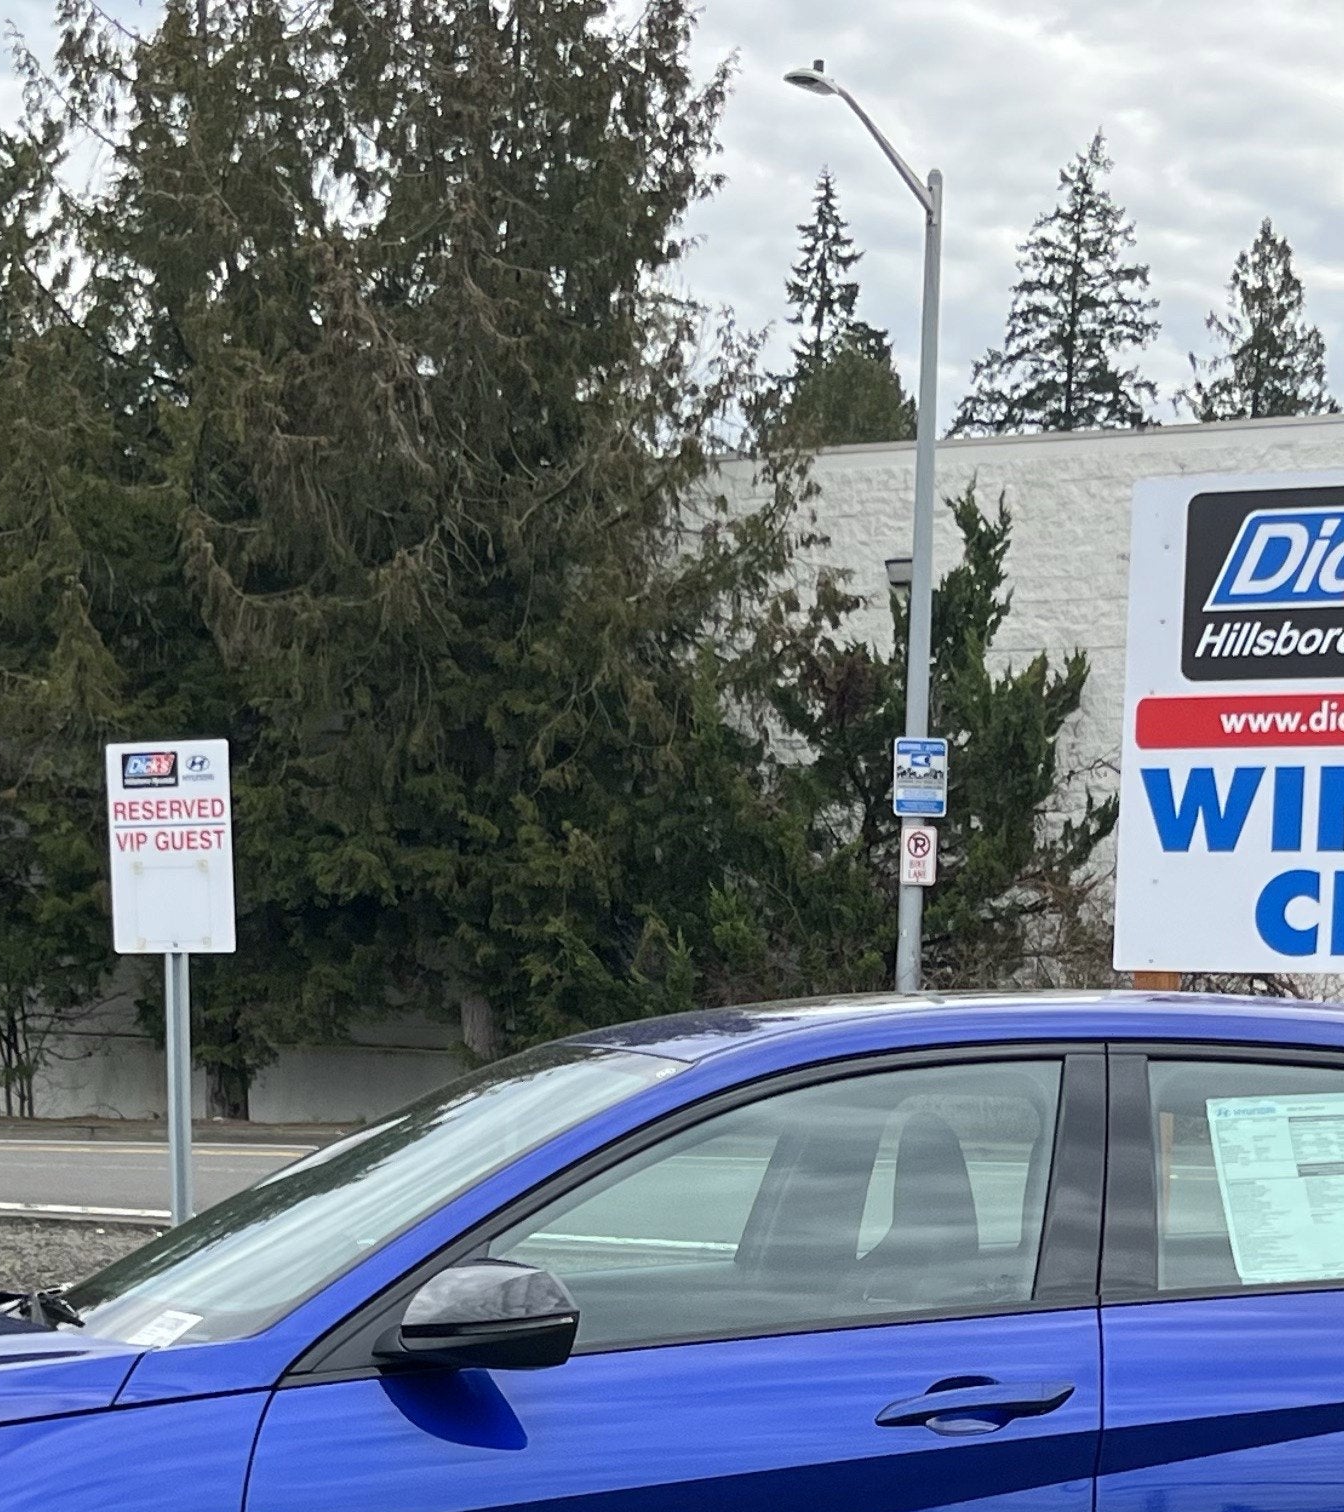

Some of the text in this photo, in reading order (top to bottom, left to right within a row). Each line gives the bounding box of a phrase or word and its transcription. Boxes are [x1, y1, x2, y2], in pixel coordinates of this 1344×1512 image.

[113, 798, 225, 821] RESERVED
[116, 829, 226, 852] VIP GUEST
